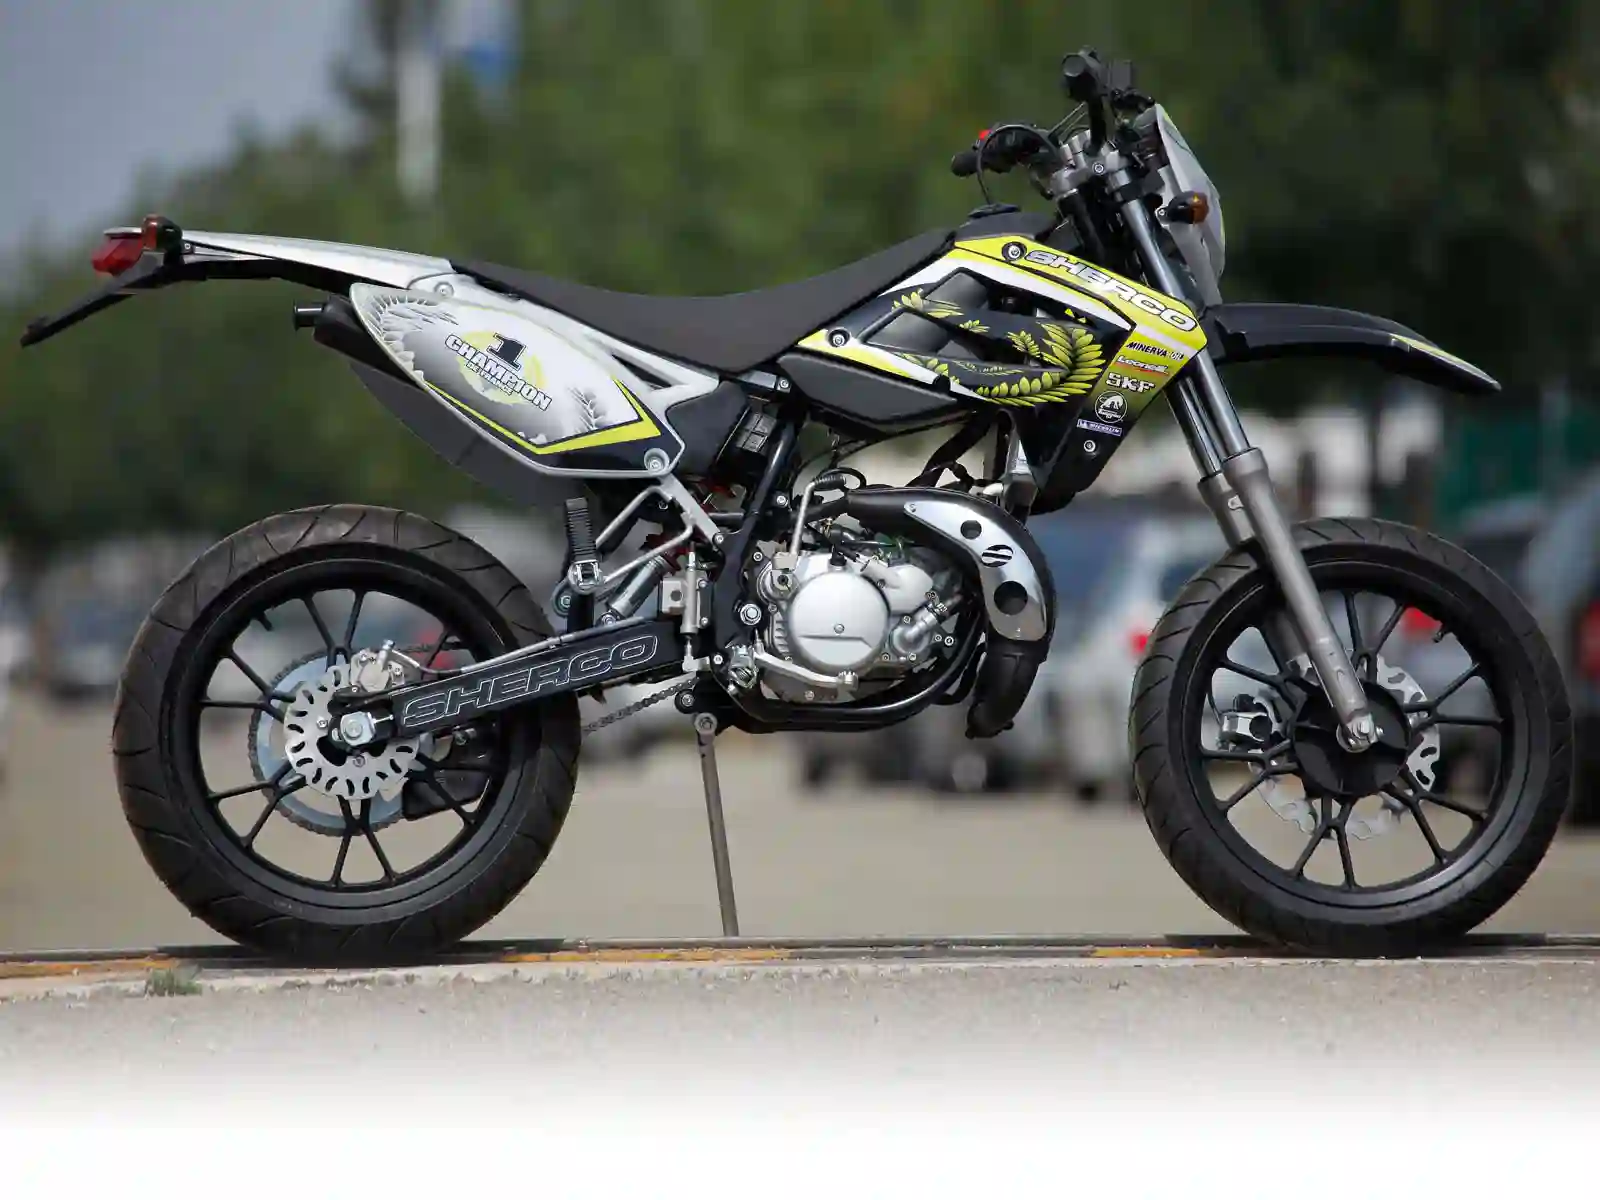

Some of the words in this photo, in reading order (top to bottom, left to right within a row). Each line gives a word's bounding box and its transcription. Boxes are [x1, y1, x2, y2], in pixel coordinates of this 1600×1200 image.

[1024, 250, 1197, 332] SHERCO
[445, 334, 552, 411] CHAMPION
[487, 332, 526, 371] 1
[1126, 341, 1168, 357] MINERVA
[1106, 372, 1155, 392] SKF
[403, 635, 658, 728] SHERCO
